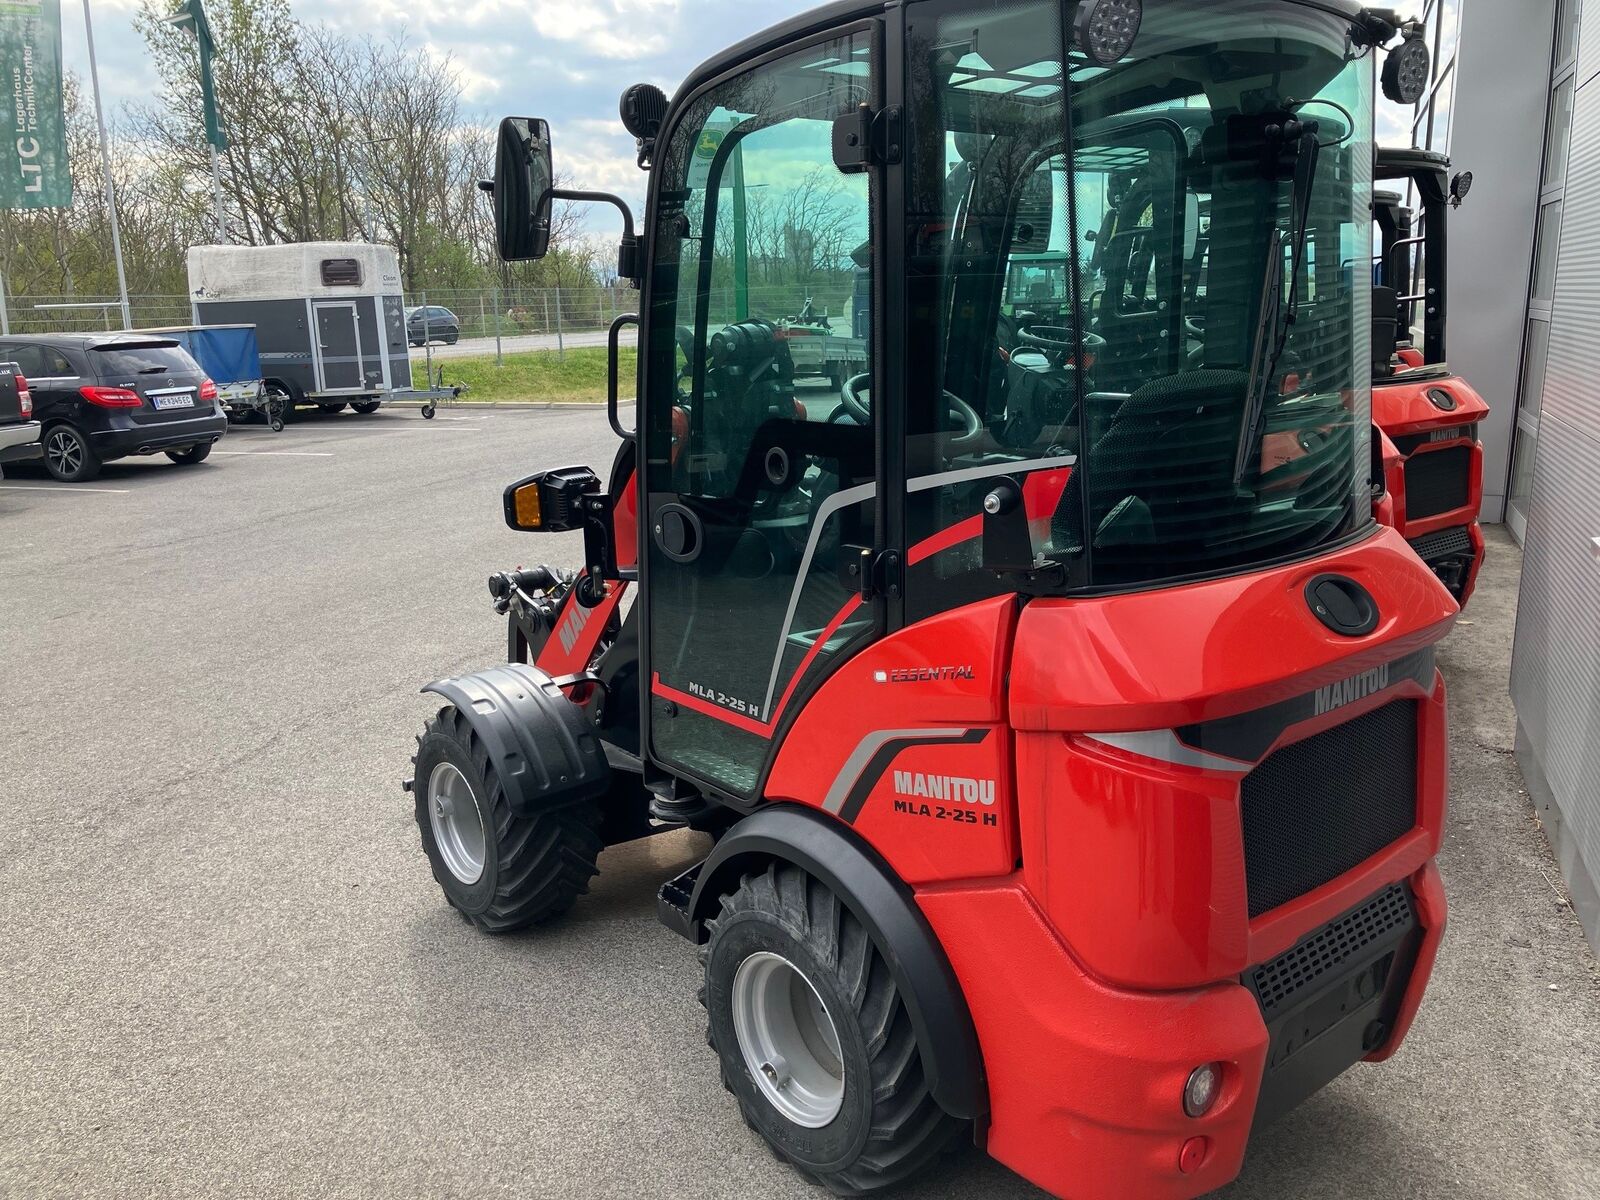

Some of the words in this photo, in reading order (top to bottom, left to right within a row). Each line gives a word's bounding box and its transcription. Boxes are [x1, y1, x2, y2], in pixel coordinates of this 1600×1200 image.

[13, 67, 26, 133] Lagerhaus
[23, 45, 37, 133] TechnikCenter
[16, 136, 43, 193] LTC
[891, 665, 976, 683] ESSENTIAL
[1314, 663, 1389, 716] MANITOU
[689, 681, 715, 701] MLA
[717, 692, 746, 712] 2-25
[748, 703, 759, 717] H
[894, 770, 996, 806] MANITOU
[894, 800, 932, 817] MLA
[935, 806, 978, 824] 2-25
[983, 812, 998, 827] H
